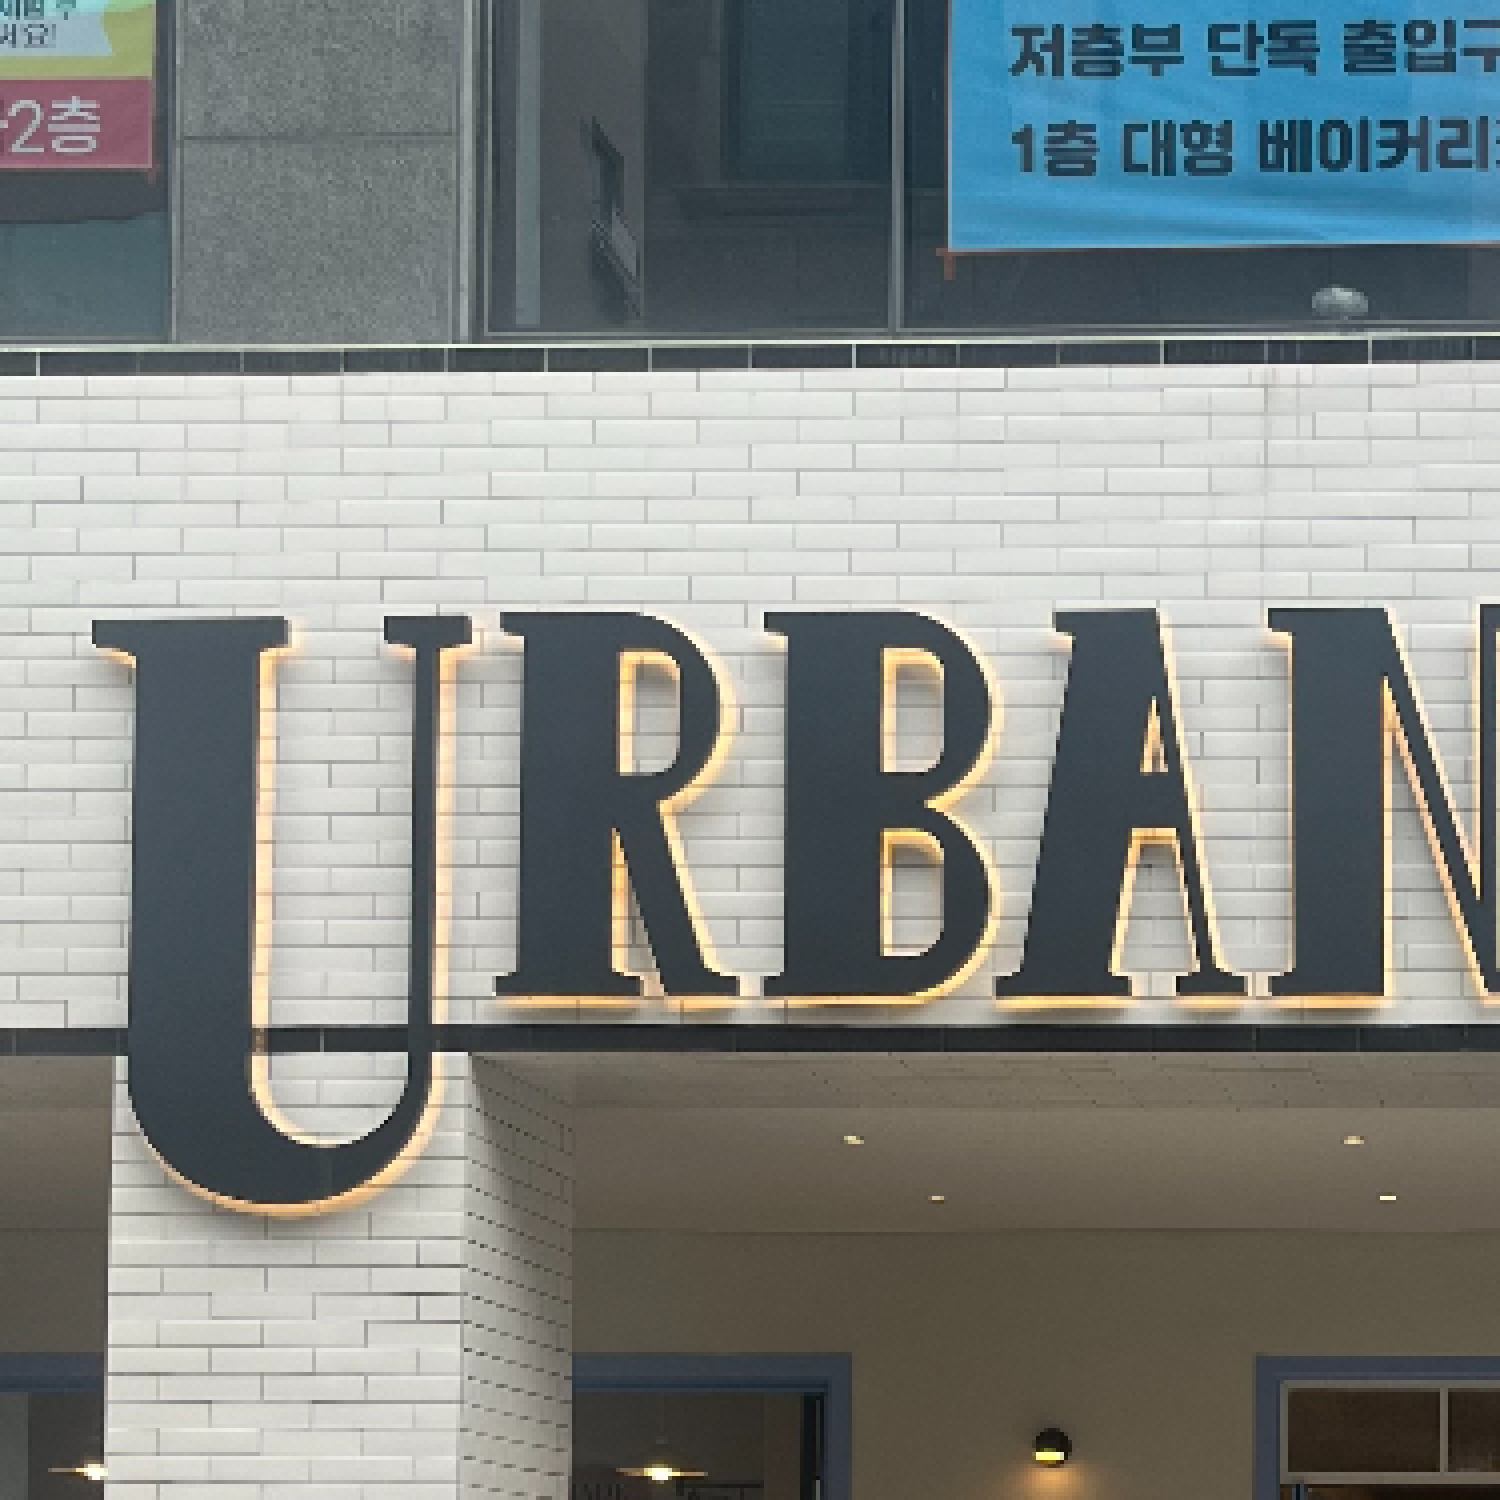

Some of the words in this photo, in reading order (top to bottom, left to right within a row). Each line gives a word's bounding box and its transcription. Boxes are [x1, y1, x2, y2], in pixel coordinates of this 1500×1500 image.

[1008, 22, 1184, 79] 저층부
[1207, 19, 1320, 78] 단독
[1011, 120, 1099, 178] 1층
[1122, 119, 1236, 178] 대형
